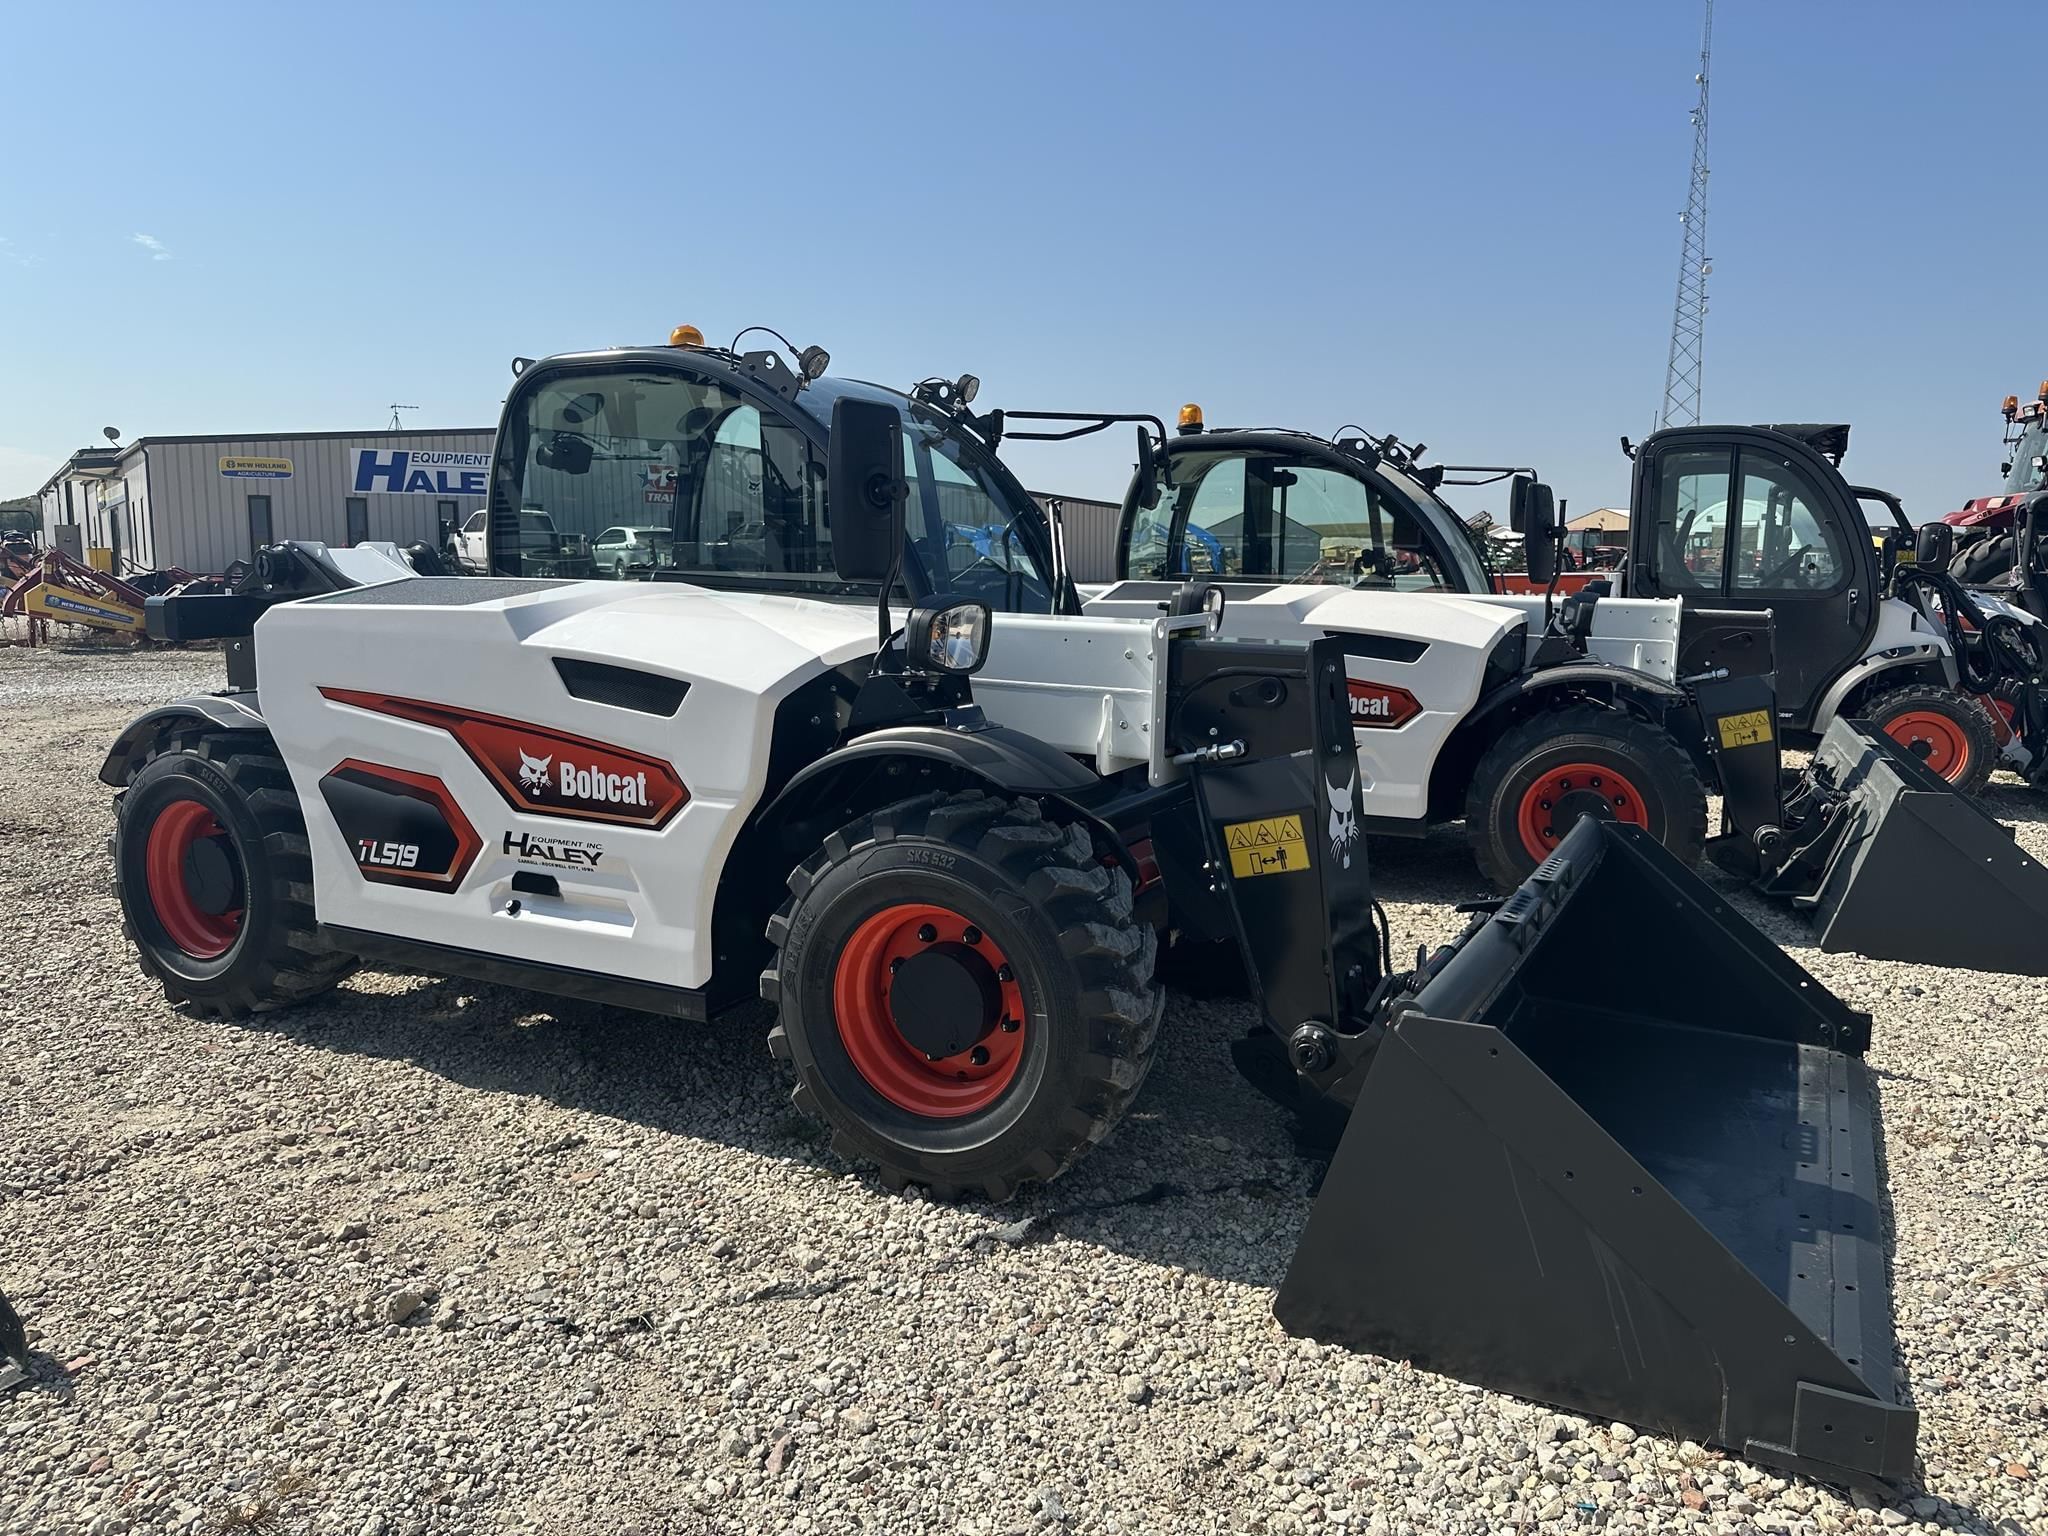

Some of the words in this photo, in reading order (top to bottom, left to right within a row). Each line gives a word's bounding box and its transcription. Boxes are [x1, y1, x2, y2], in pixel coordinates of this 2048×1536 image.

[354, 450, 490, 494] HALE
[411, 452, 491, 466] EQUIPMENT
[75, 604, 100, 614] HOLLAND
[1348, 692, 1390, 716] bcat
[559, 761, 648, 807] Bobcat
[358, 839, 420, 868] TL519
[502, 830, 604, 866] HALEY
[531, 836, 584, 848] EQUIPMENT
